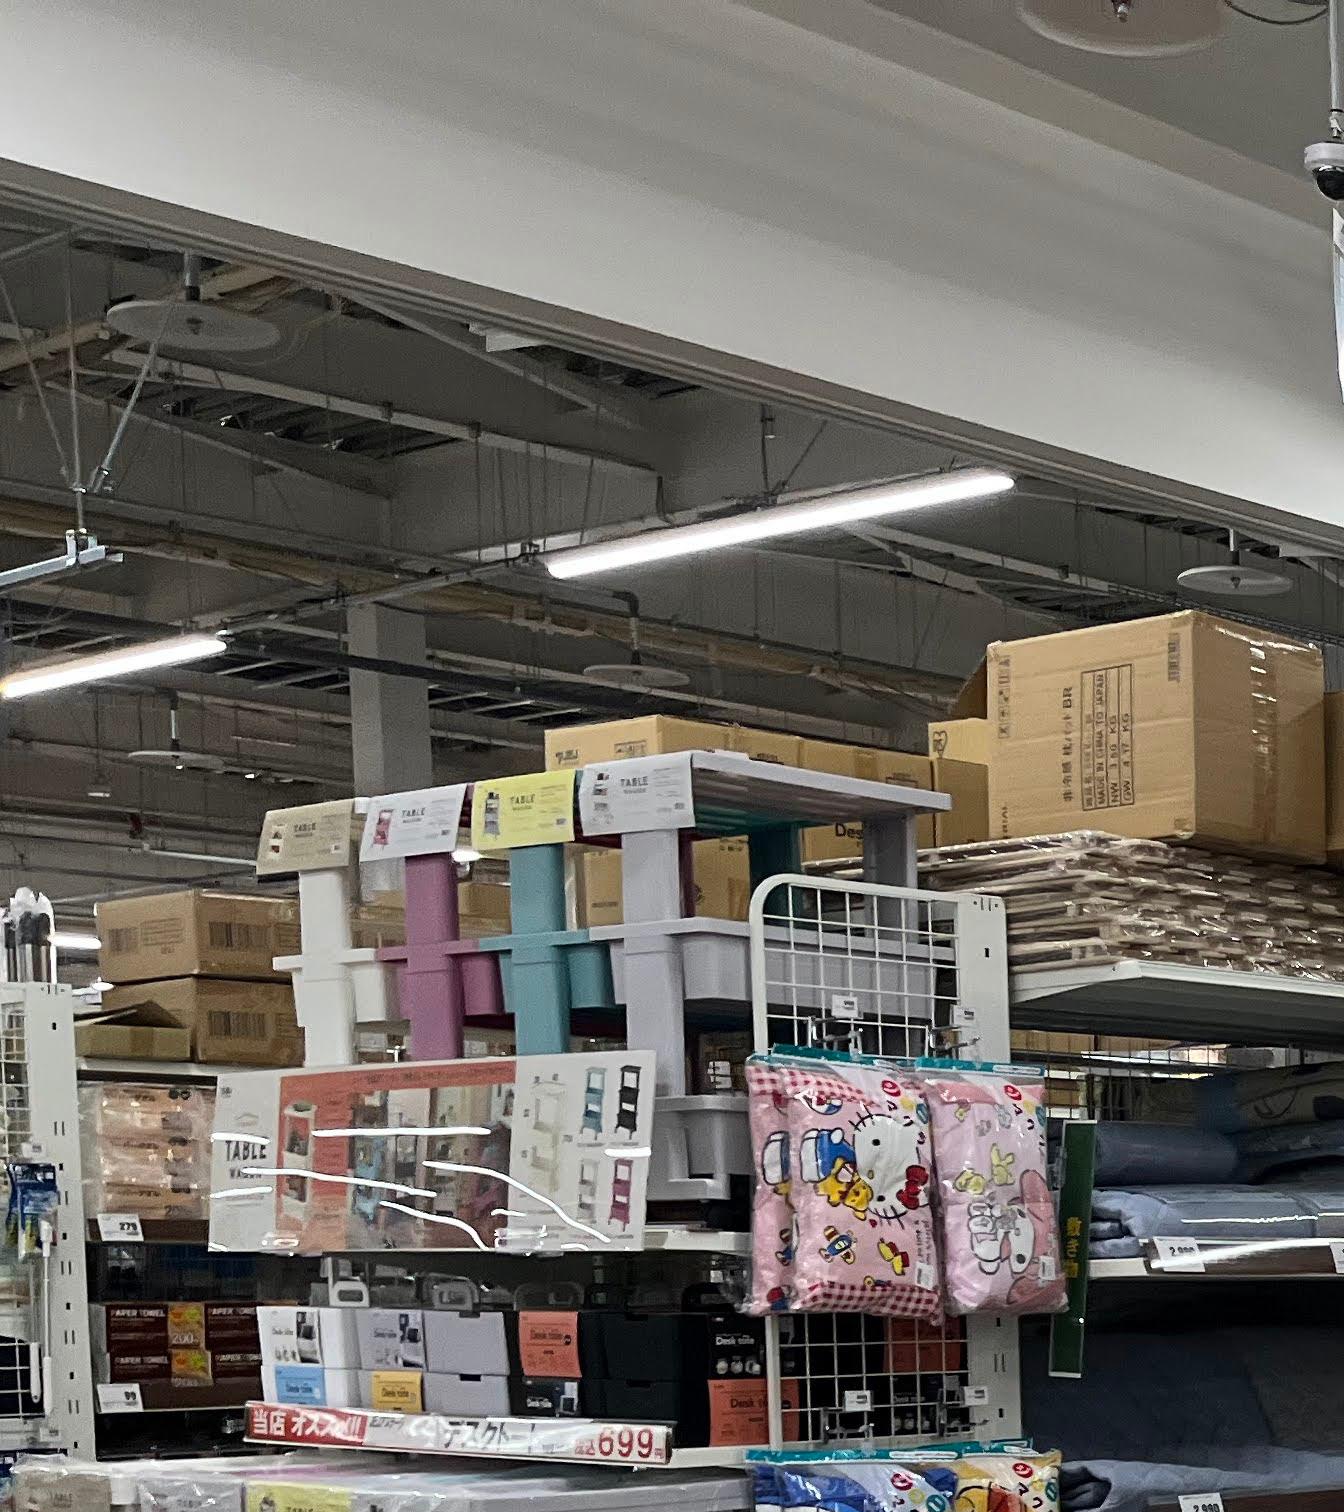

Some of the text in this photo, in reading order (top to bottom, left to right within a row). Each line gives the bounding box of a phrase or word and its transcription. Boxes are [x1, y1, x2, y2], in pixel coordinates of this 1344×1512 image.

[1062, 686, 1073, 709] BR
[620, 776, 648, 788] TABLE
[225, 1139, 267, 1161] TABLE
[252, 1409, 286, 1437] 当店
